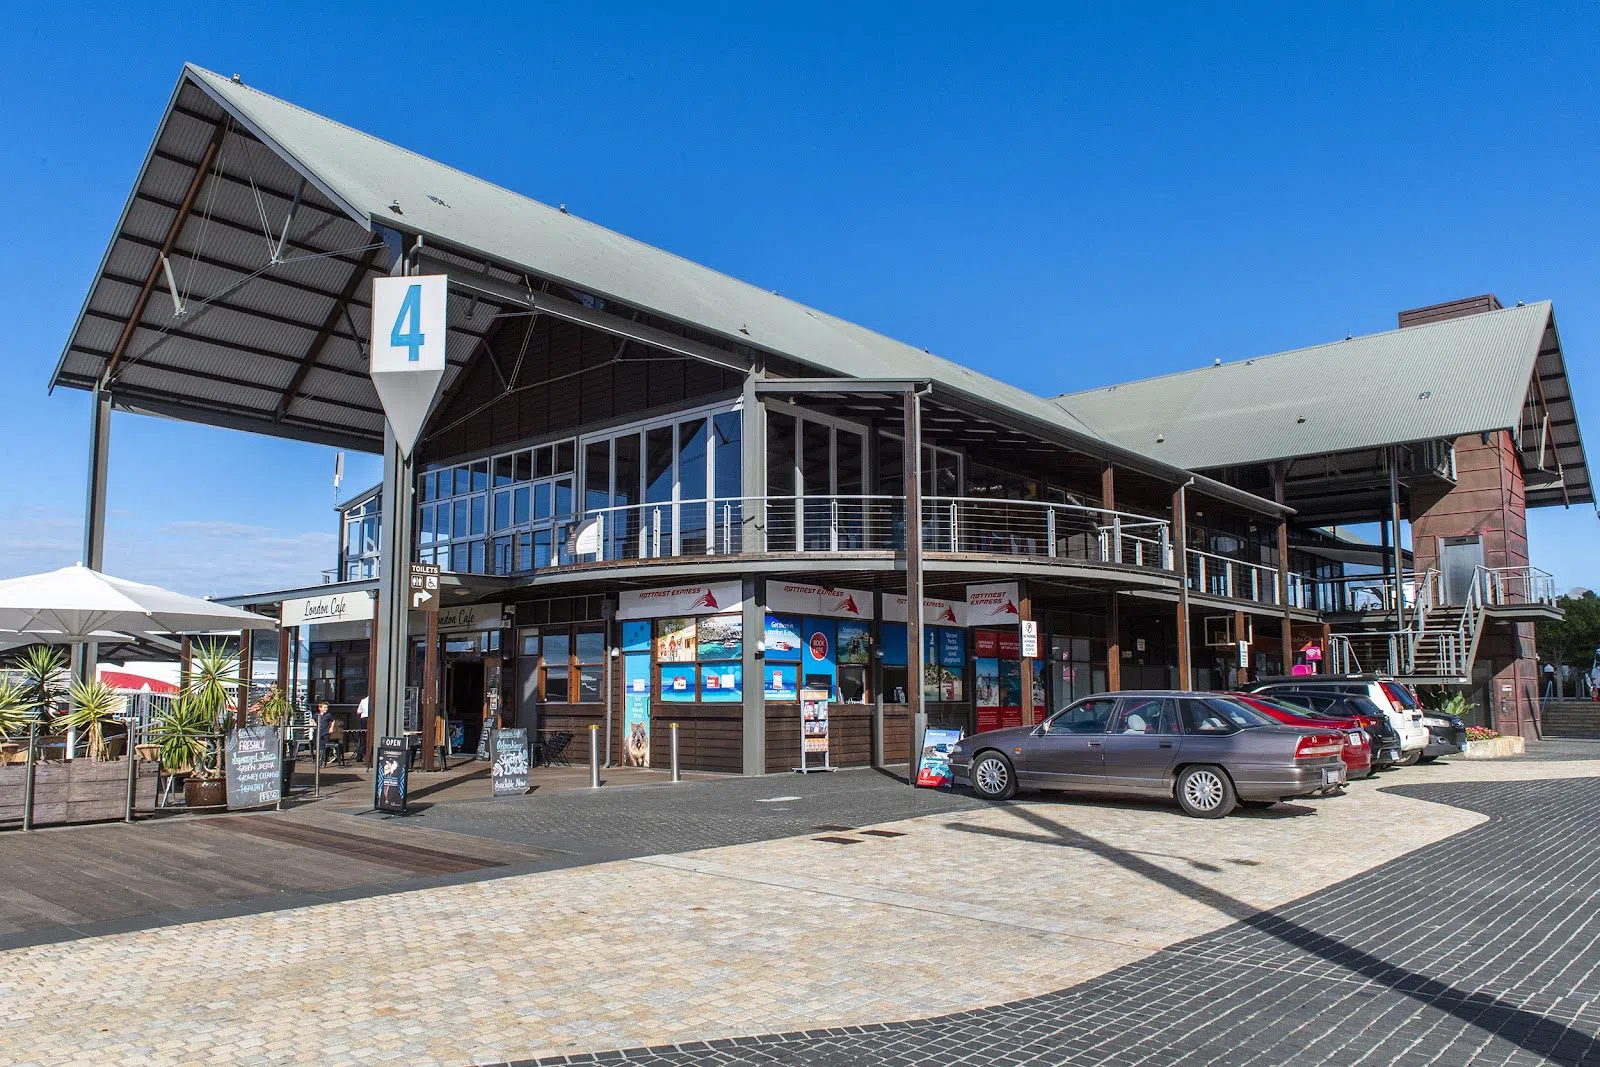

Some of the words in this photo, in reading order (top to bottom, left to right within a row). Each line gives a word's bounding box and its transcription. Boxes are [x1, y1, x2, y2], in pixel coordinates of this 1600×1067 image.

[391, 285, 425, 361] 4
[412, 565, 438, 574] TOILETS
[639, 591, 670, 600] ROTTNEST
[672, 587, 702, 596] EXPRESS
[783, 585, 815, 595] ROTTNEST
[817, 588, 844, 597] EXPRESS
[970, 591, 1007, 600] ROTTNEST
[304, 599, 328, 617] London
[331, 597, 346, 619] Cafe
[459, 607, 475, 628] Cafe
[238, 740, 266, 751] FRESHLY
[386, 739, 402, 747] OPEN
